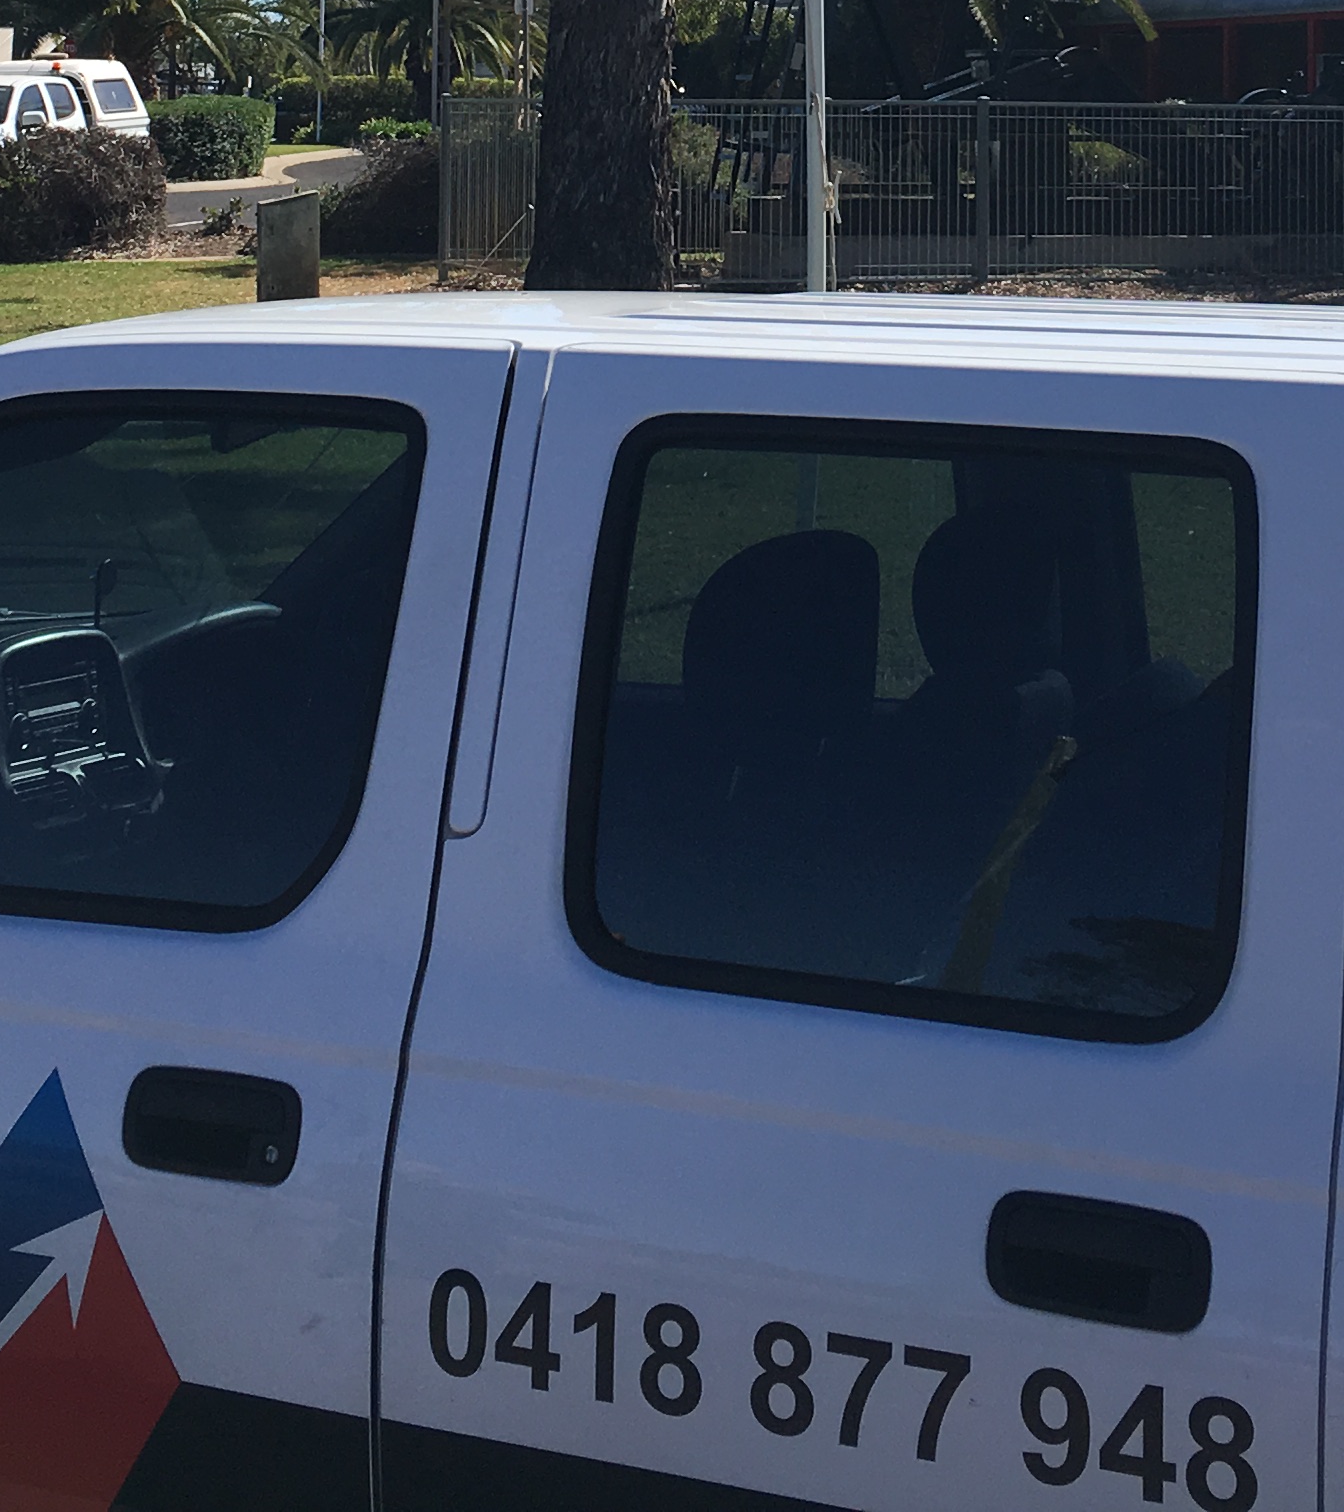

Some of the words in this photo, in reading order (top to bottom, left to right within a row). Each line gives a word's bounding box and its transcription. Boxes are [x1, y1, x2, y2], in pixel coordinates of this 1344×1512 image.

[428, 1268, 702, 1417] 0418
[749, 1321, 972, 1462] 877
[1020, 1367, 1258, 1512] 948
